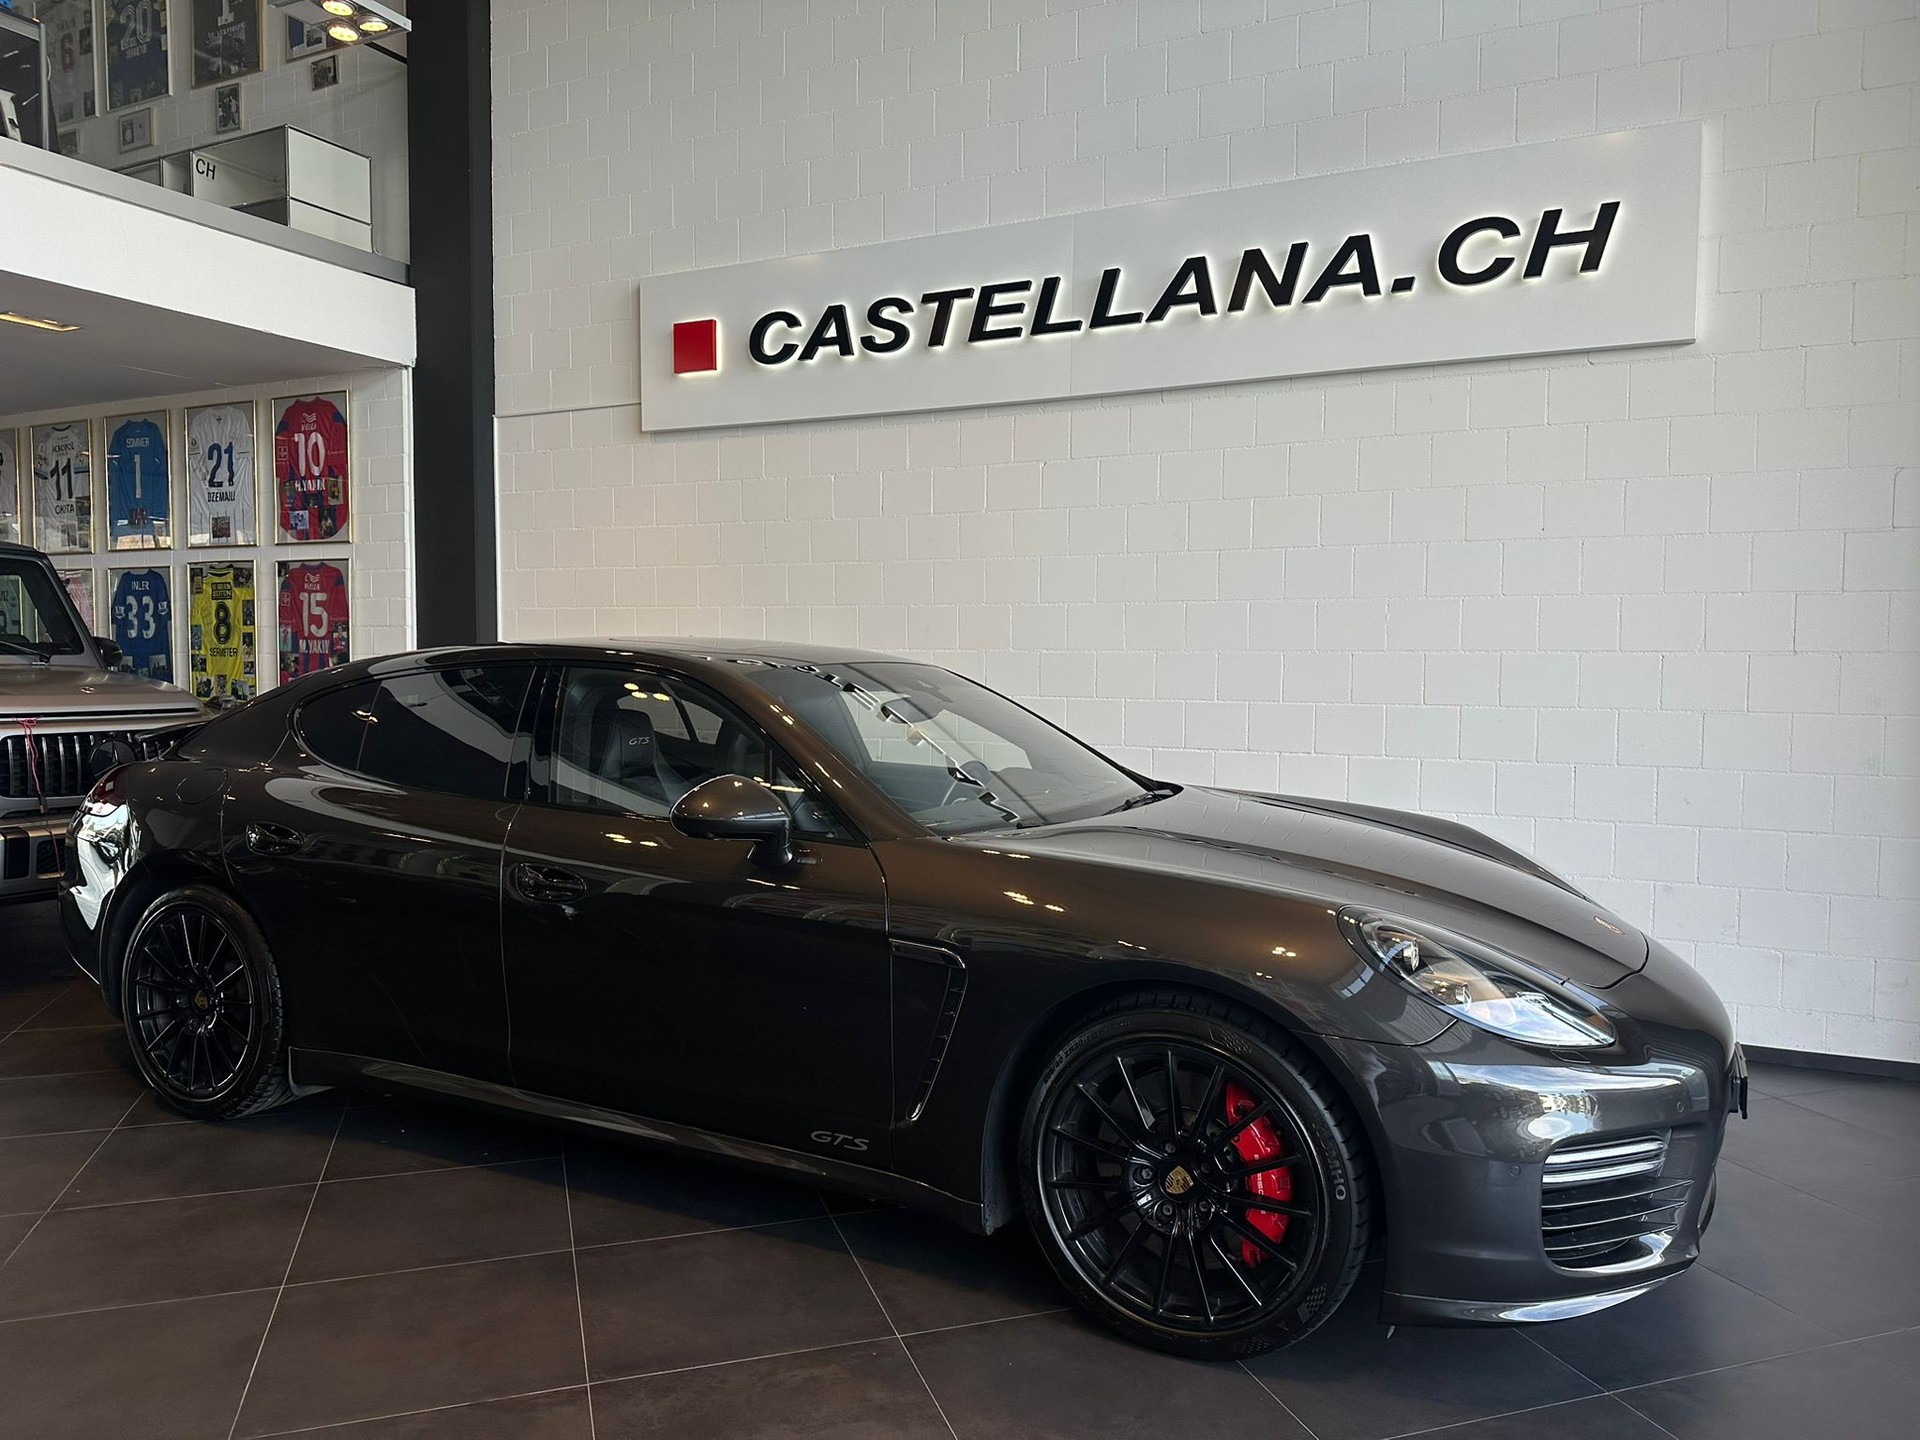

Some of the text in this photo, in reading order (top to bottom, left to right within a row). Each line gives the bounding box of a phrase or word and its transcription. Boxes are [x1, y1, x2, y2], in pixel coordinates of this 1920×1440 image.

[120, 0, 152, 51] 20
[195, 157, 216, 180] CH
[748, 201, 1622, 366] CASTELLANA.CH
[126, 437, 150, 448] SOMMER
[207, 441, 235, 488] 21
[294, 431, 326, 478] 10
[49, 457, 74, 501] 11
[134, 453, 142, 499] 1
[54, 503, 75, 515] OKITA
[131, 580, 150, 591] INLER
[125, 595, 157, 639] 33
[212, 601, 232, 645] 8
[299, 592, 329, 638] 15
[208, 646, 239, 658] SERMETER
[628, 736, 651, 746] GTS
[810, 1130, 870, 1151] GTS
